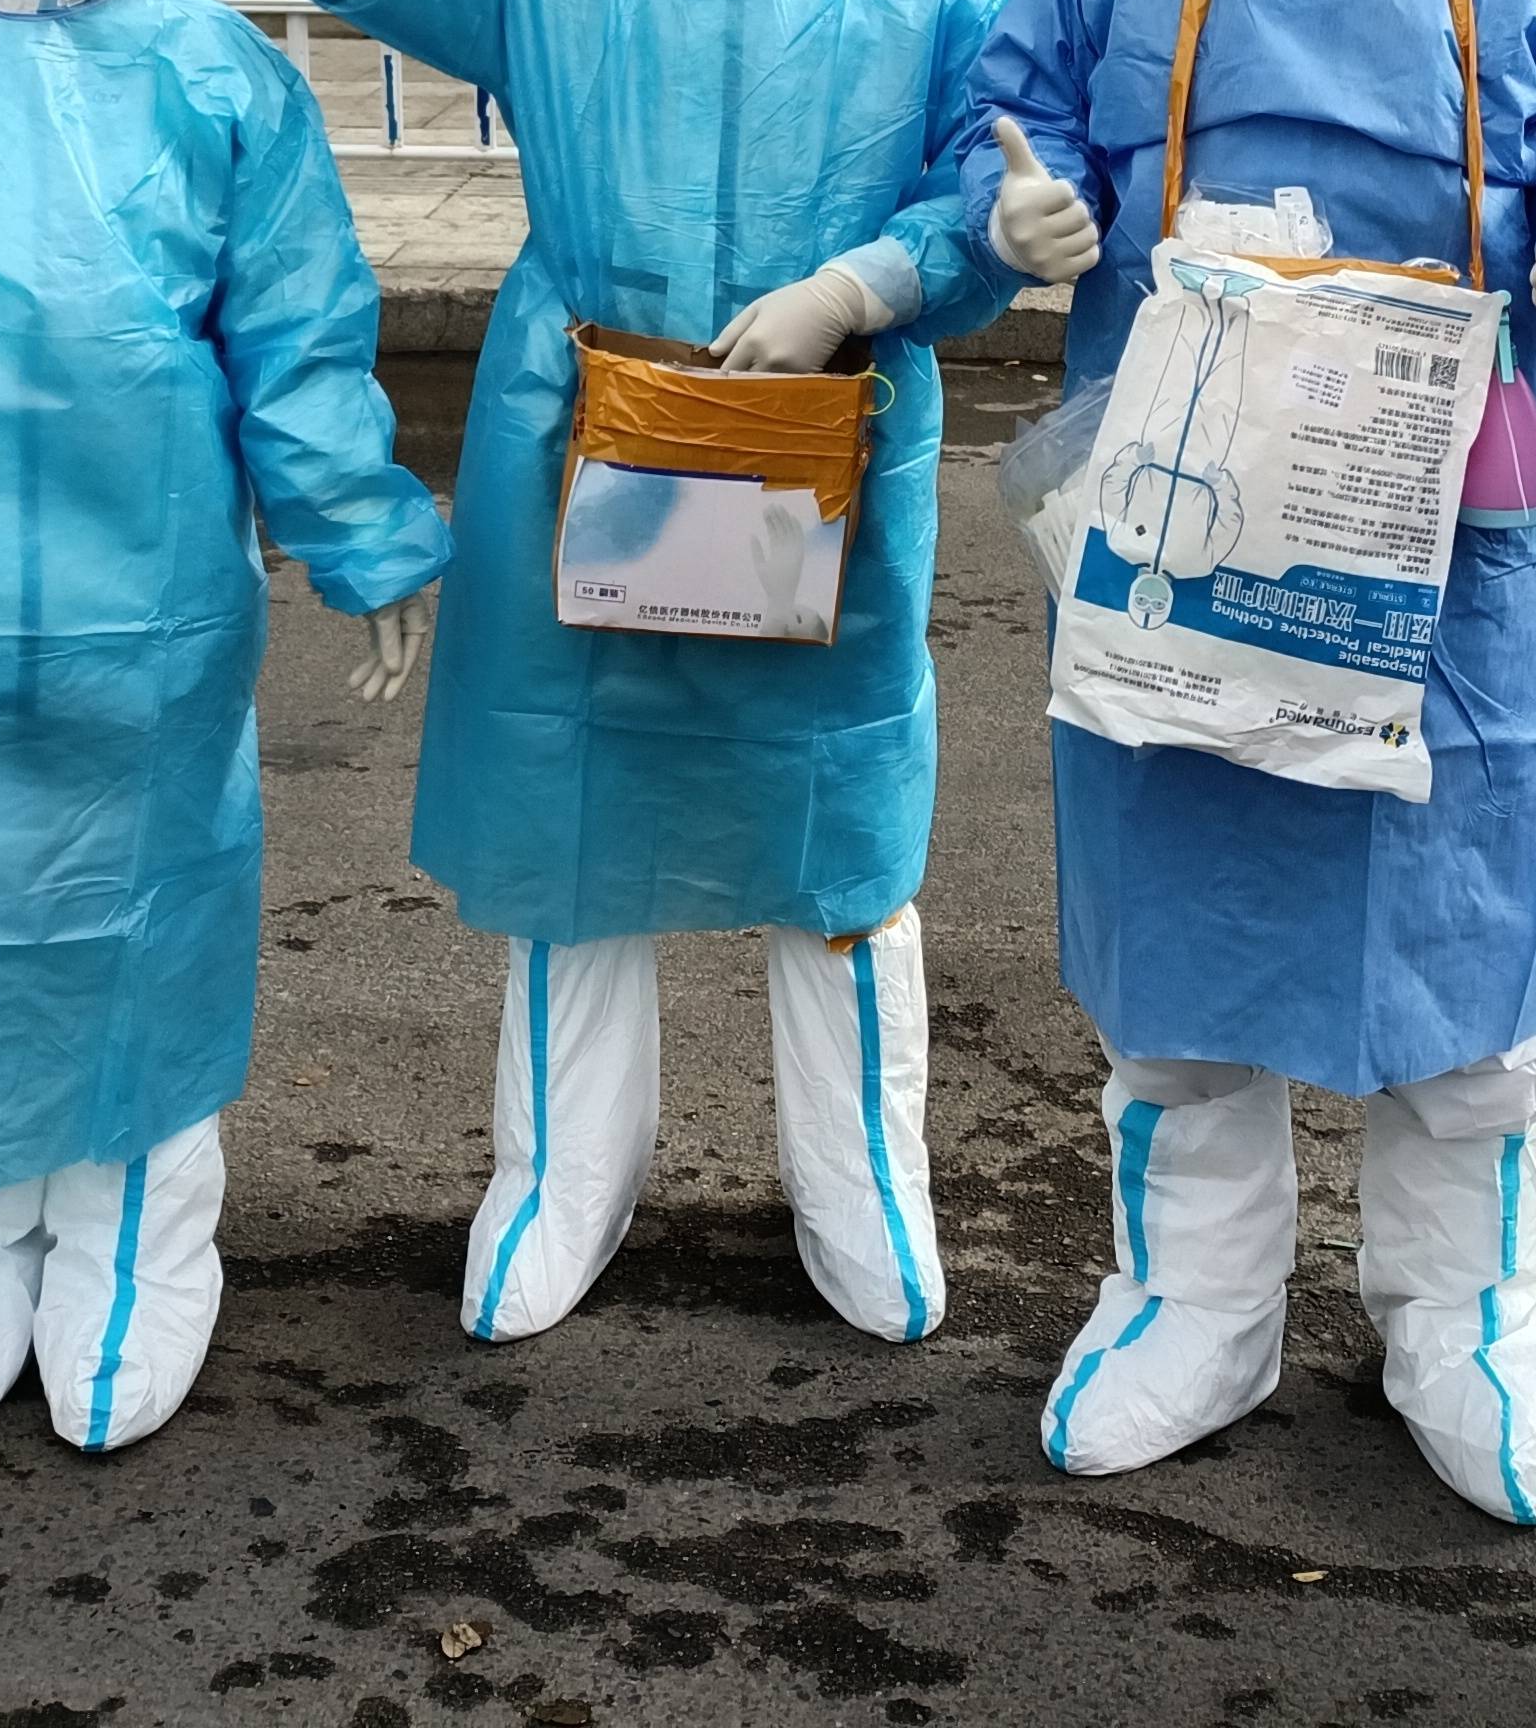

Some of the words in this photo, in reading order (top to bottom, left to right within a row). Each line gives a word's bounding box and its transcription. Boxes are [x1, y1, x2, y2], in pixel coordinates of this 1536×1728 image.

[1210, 571, 1436, 646] 医用一次性防护服
[1211, 600, 1274, 632] Clothing
[1279, 621, 1360, 651] Protective
[1367, 640, 1426, 661] Medical
[1337, 651, 1424, 679] Disposable
